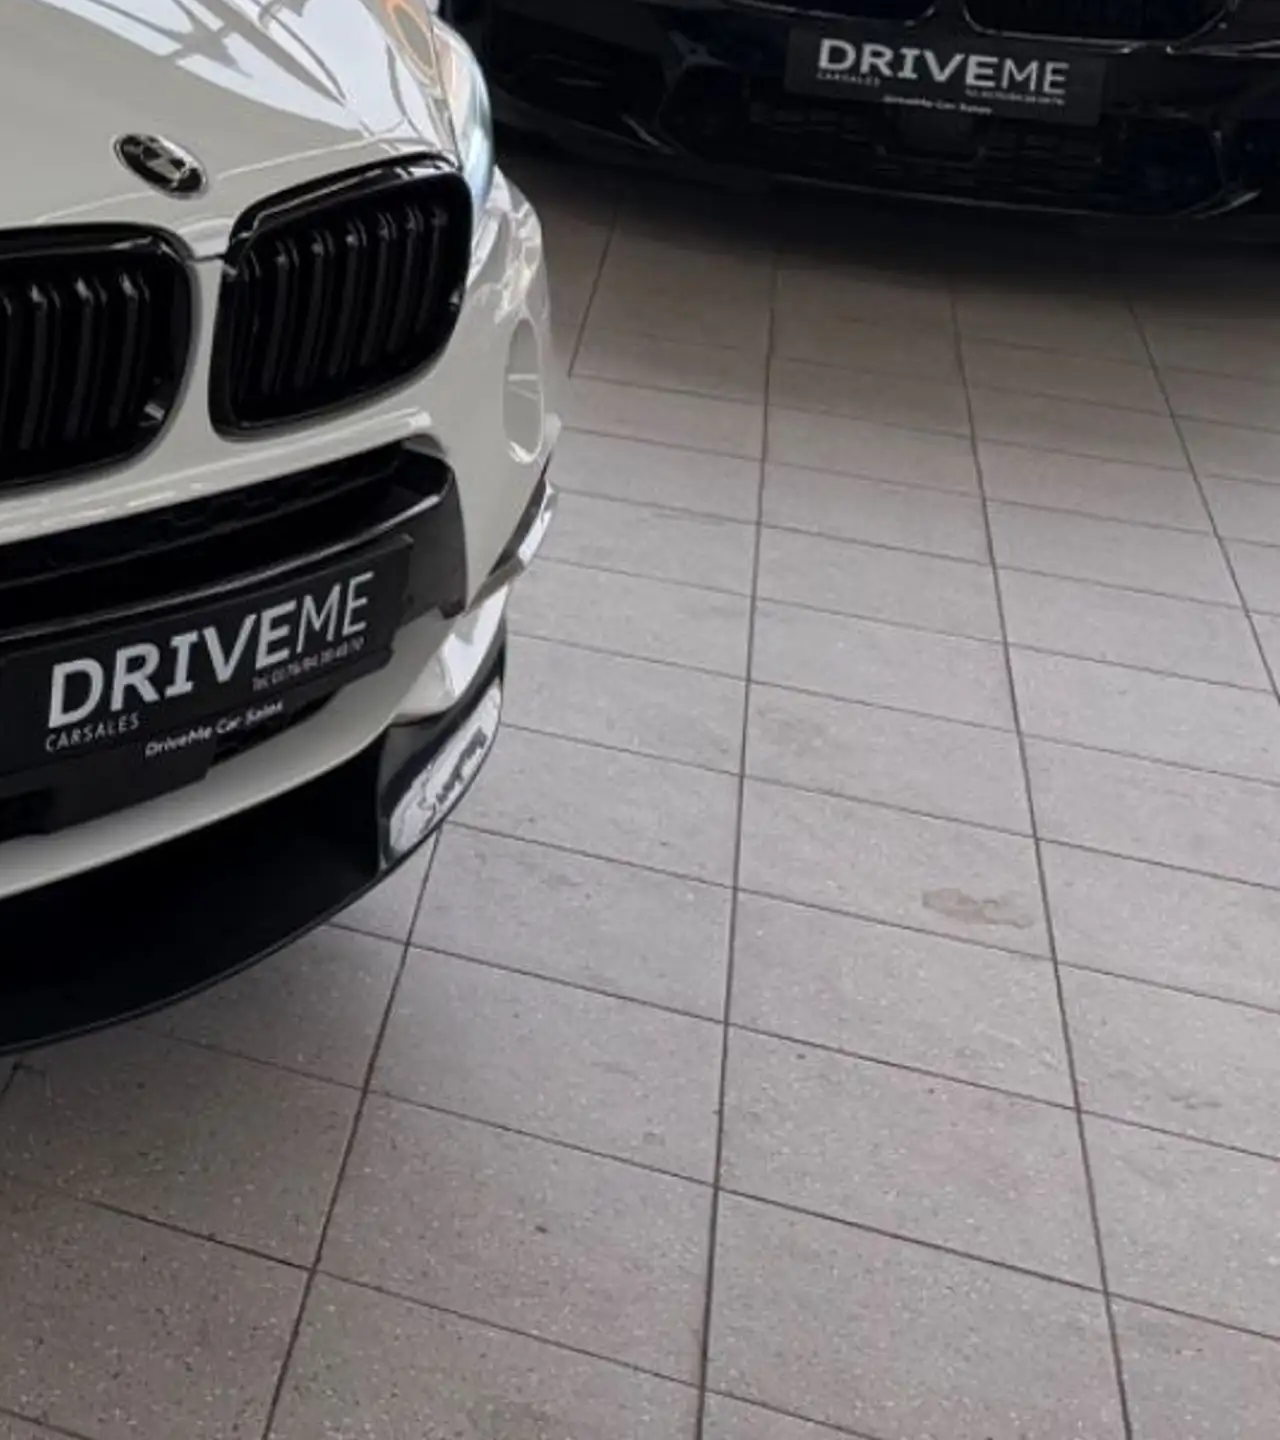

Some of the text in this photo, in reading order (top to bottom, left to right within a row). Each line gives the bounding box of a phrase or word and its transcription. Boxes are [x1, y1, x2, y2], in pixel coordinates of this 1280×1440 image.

[818, 38, 1069, 95] DRIVEME
[48, 571, 375, 728] DRIVEME
[45, 710, 139, 753] CARSALES
